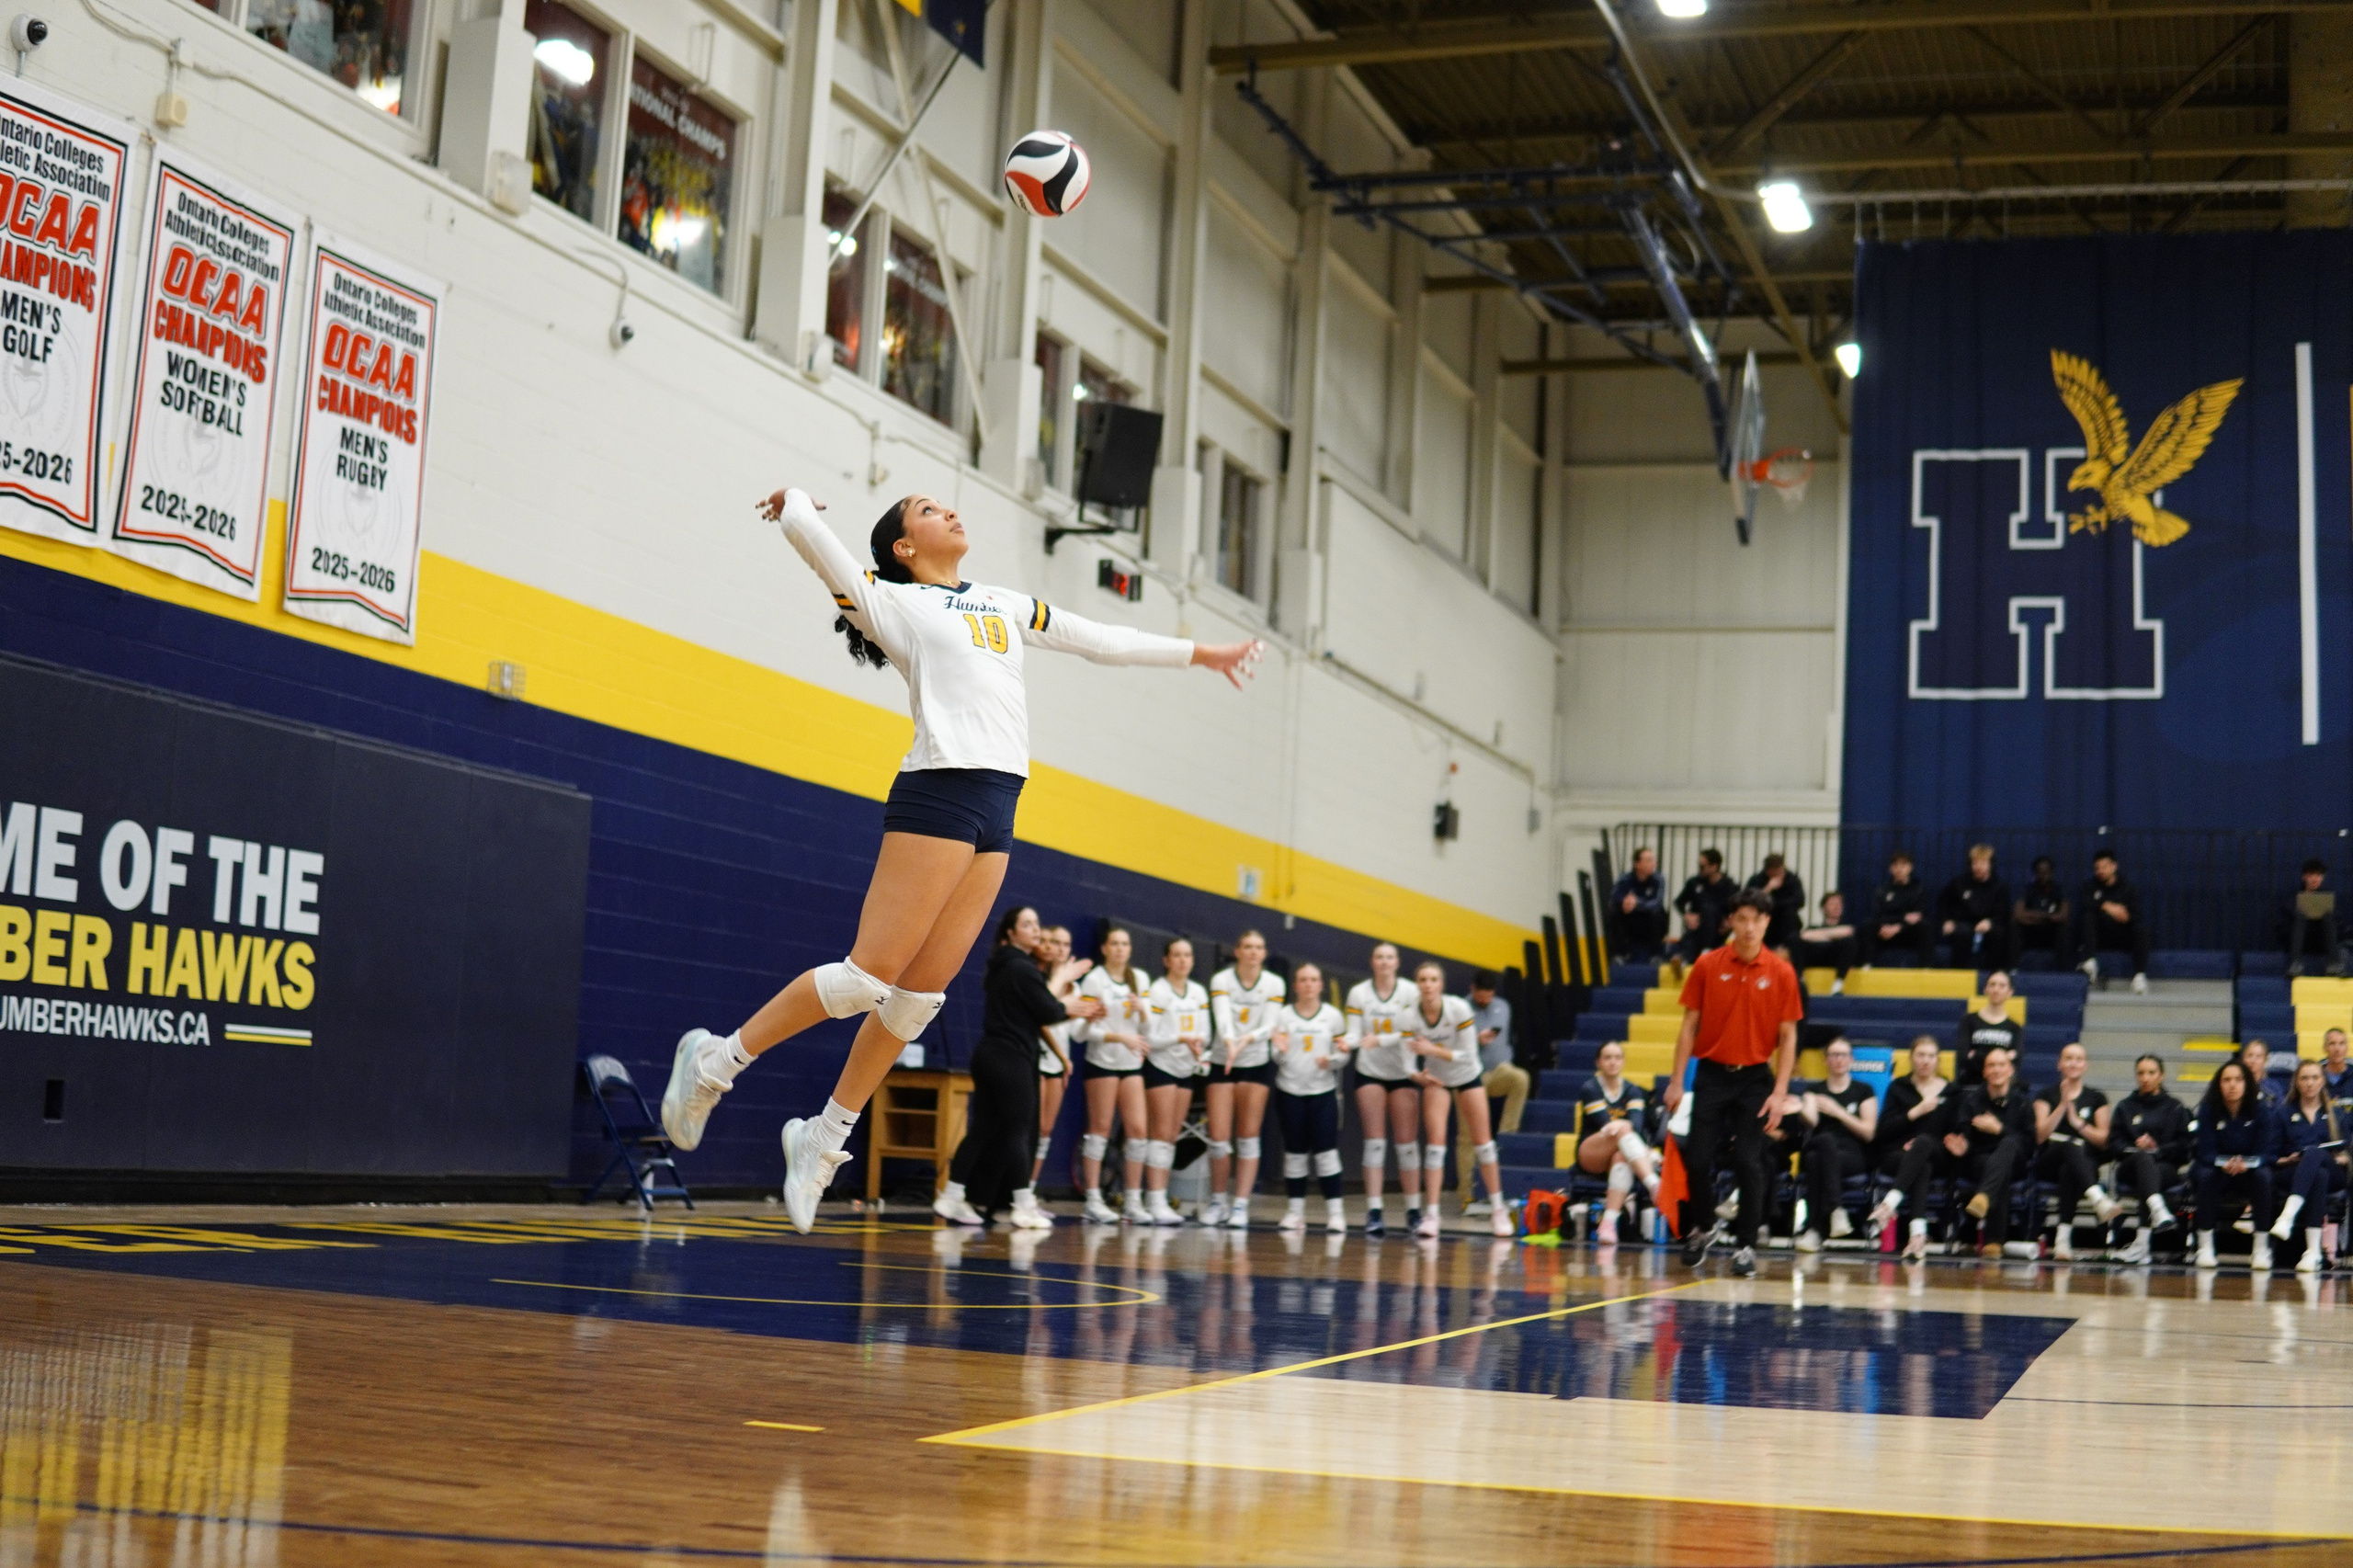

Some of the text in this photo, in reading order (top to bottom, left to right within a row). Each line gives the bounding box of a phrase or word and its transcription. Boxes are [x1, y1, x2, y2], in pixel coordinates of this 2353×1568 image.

[0, 113, 104, 174] ntario Colleges
[677, 114, 726, 160] CHAMPS
[34, 153, 109, 202] Association
[177, 191, 270, 256] Ontario Colleges
[0, 237, 96, 312] AMPIONS
[162, 244, 267, 338] OCAA
[334, 273, 417, 325] Ontario Colleges
[1, 290, 62, 335] MEN'S
[324, 290, 426, 349] Athletic Association
[4, 324, 54, 363] GOLF
[153, 299, 267, 384] CHAMPIONS
[323, 323, 417, 402] OCAA
[166, 350, 247, 408] WOMEN'S
[160, 381, 243, 437] SOFTBALL
[318, 374, 417, 445] CHAMPIONS
[0, 442, 73, 485] 5-2026
[340, 426, 388, 463] MEN'S
[336, 454, 388, 492] RUGBY
[141, 485, 237, 541] 2025-2026
[312, 547, 395, 593] 2025-2026
[963, 613, 1008, 654] 10
[100, 819, 194, 915] OF
[209, 835, 324, 936] THE
[0, 903, 316, 1011] BER HAWKS
